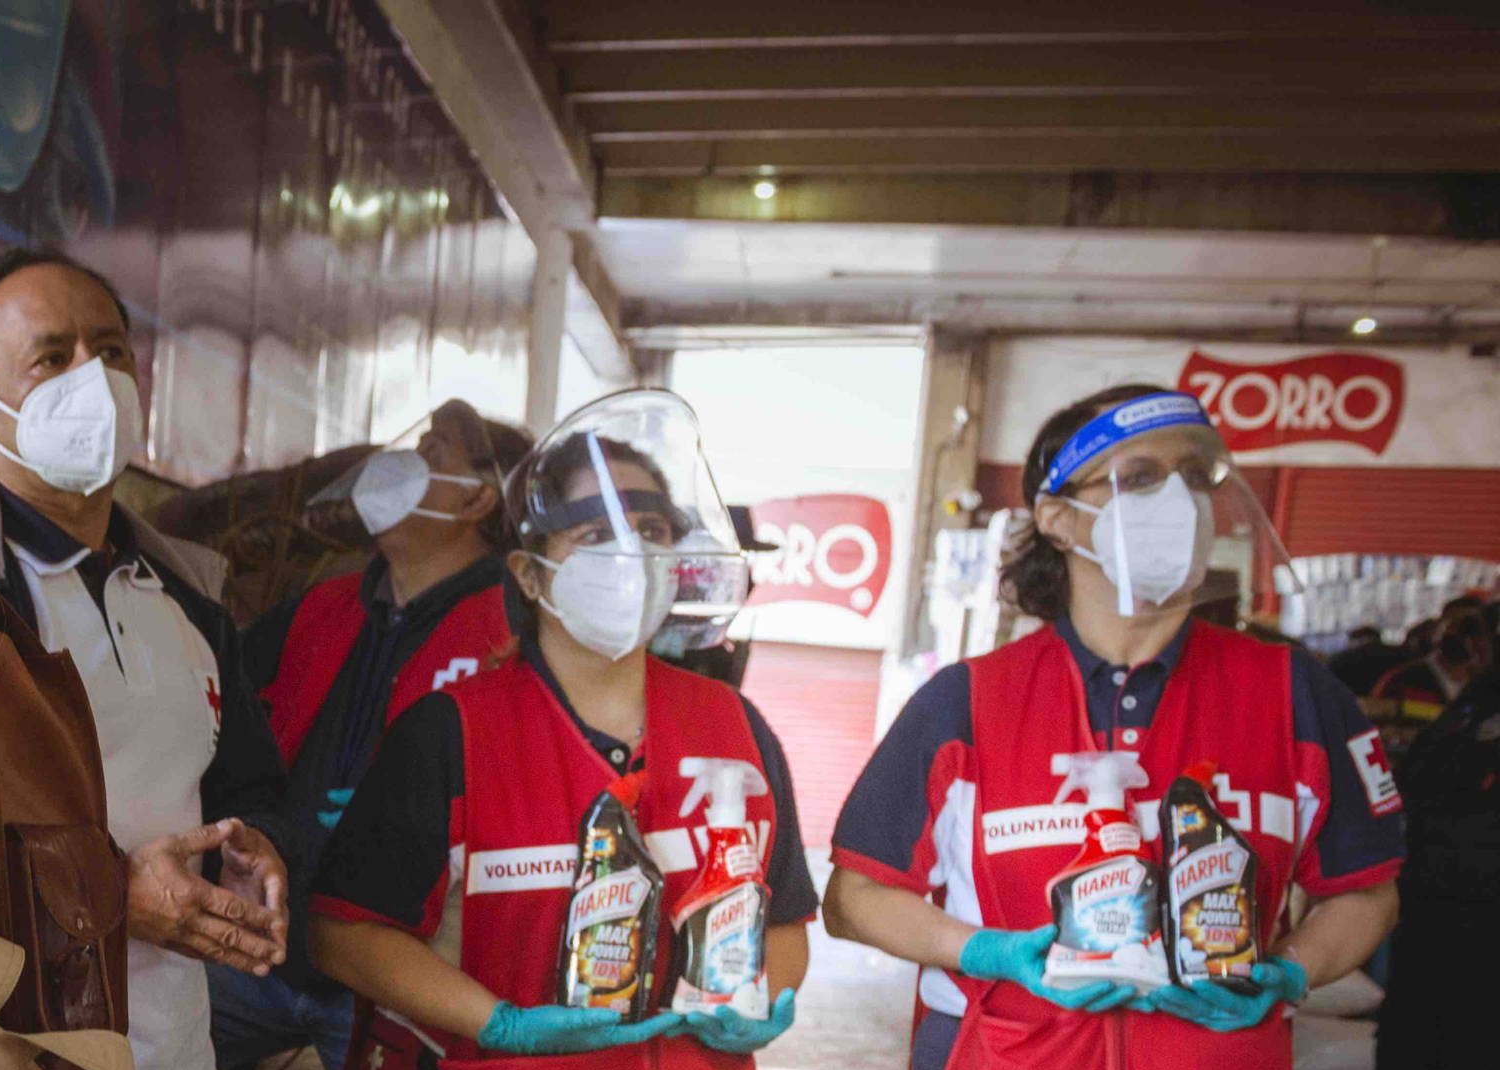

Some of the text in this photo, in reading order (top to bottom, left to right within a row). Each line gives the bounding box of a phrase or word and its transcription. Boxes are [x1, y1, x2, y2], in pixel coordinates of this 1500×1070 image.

[1189, 371, 1393, 432] ZORRO
[983, 815, 1086, 839] OLUNTARI
[1077, 867, 1132, 901] HARPIC
[1175, 851, 1234, 895] HARPIC
[574, 880, 636, 922] HARPIC
[1203, 892, 1238, 911] MAX
[1196, 910, 1242, 926] POWER
[595, 924, 632, 944] MAX
